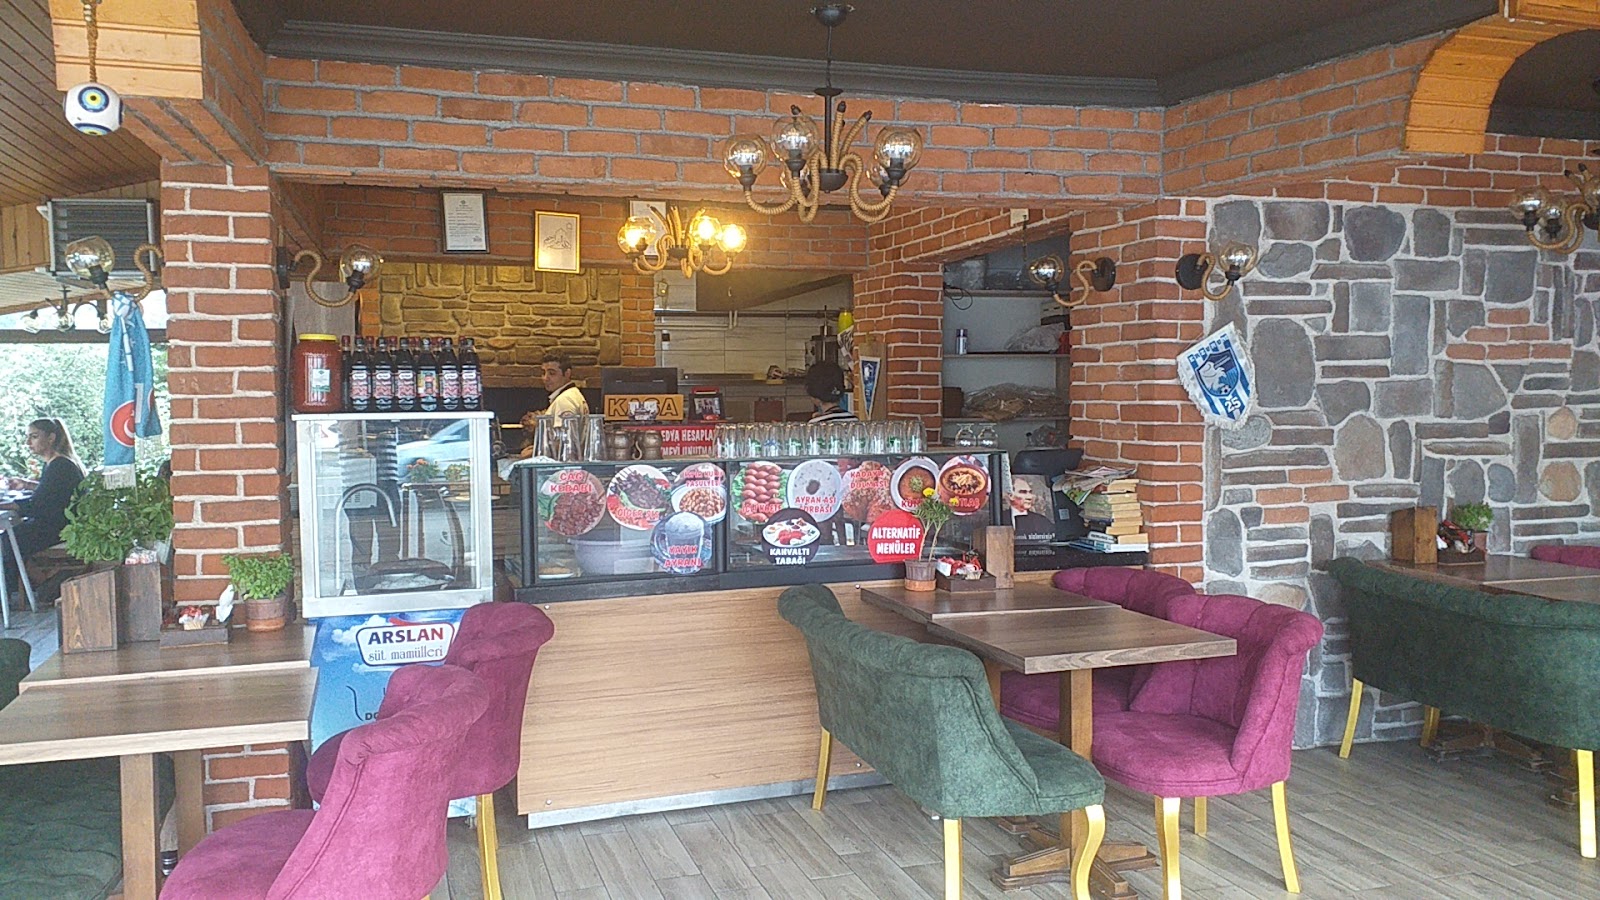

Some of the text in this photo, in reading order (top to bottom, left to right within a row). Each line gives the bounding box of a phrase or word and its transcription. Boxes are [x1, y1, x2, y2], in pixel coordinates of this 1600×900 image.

[608, 397, 679, 416] KA
[1224, 397, 1241, 413] 25
[660, 429, 715, 442] EDYA HESAPLA
[794, 496, 821, 504] AYRAN
[871, 524, 921, 540] ALTERNATİF
[669, 544, 698, 555] YAYIK
[769, 547, 811, 556] KAHVALTI
[876, 539, 916, 555] MENÜLER
[663, 558, 702, 568] AYRANI
[775, 556, 807, 565] TABAĞI
[368, 627, 444, 645] ARSLAN
[368, 645, 443, 662] süt mamülleri
